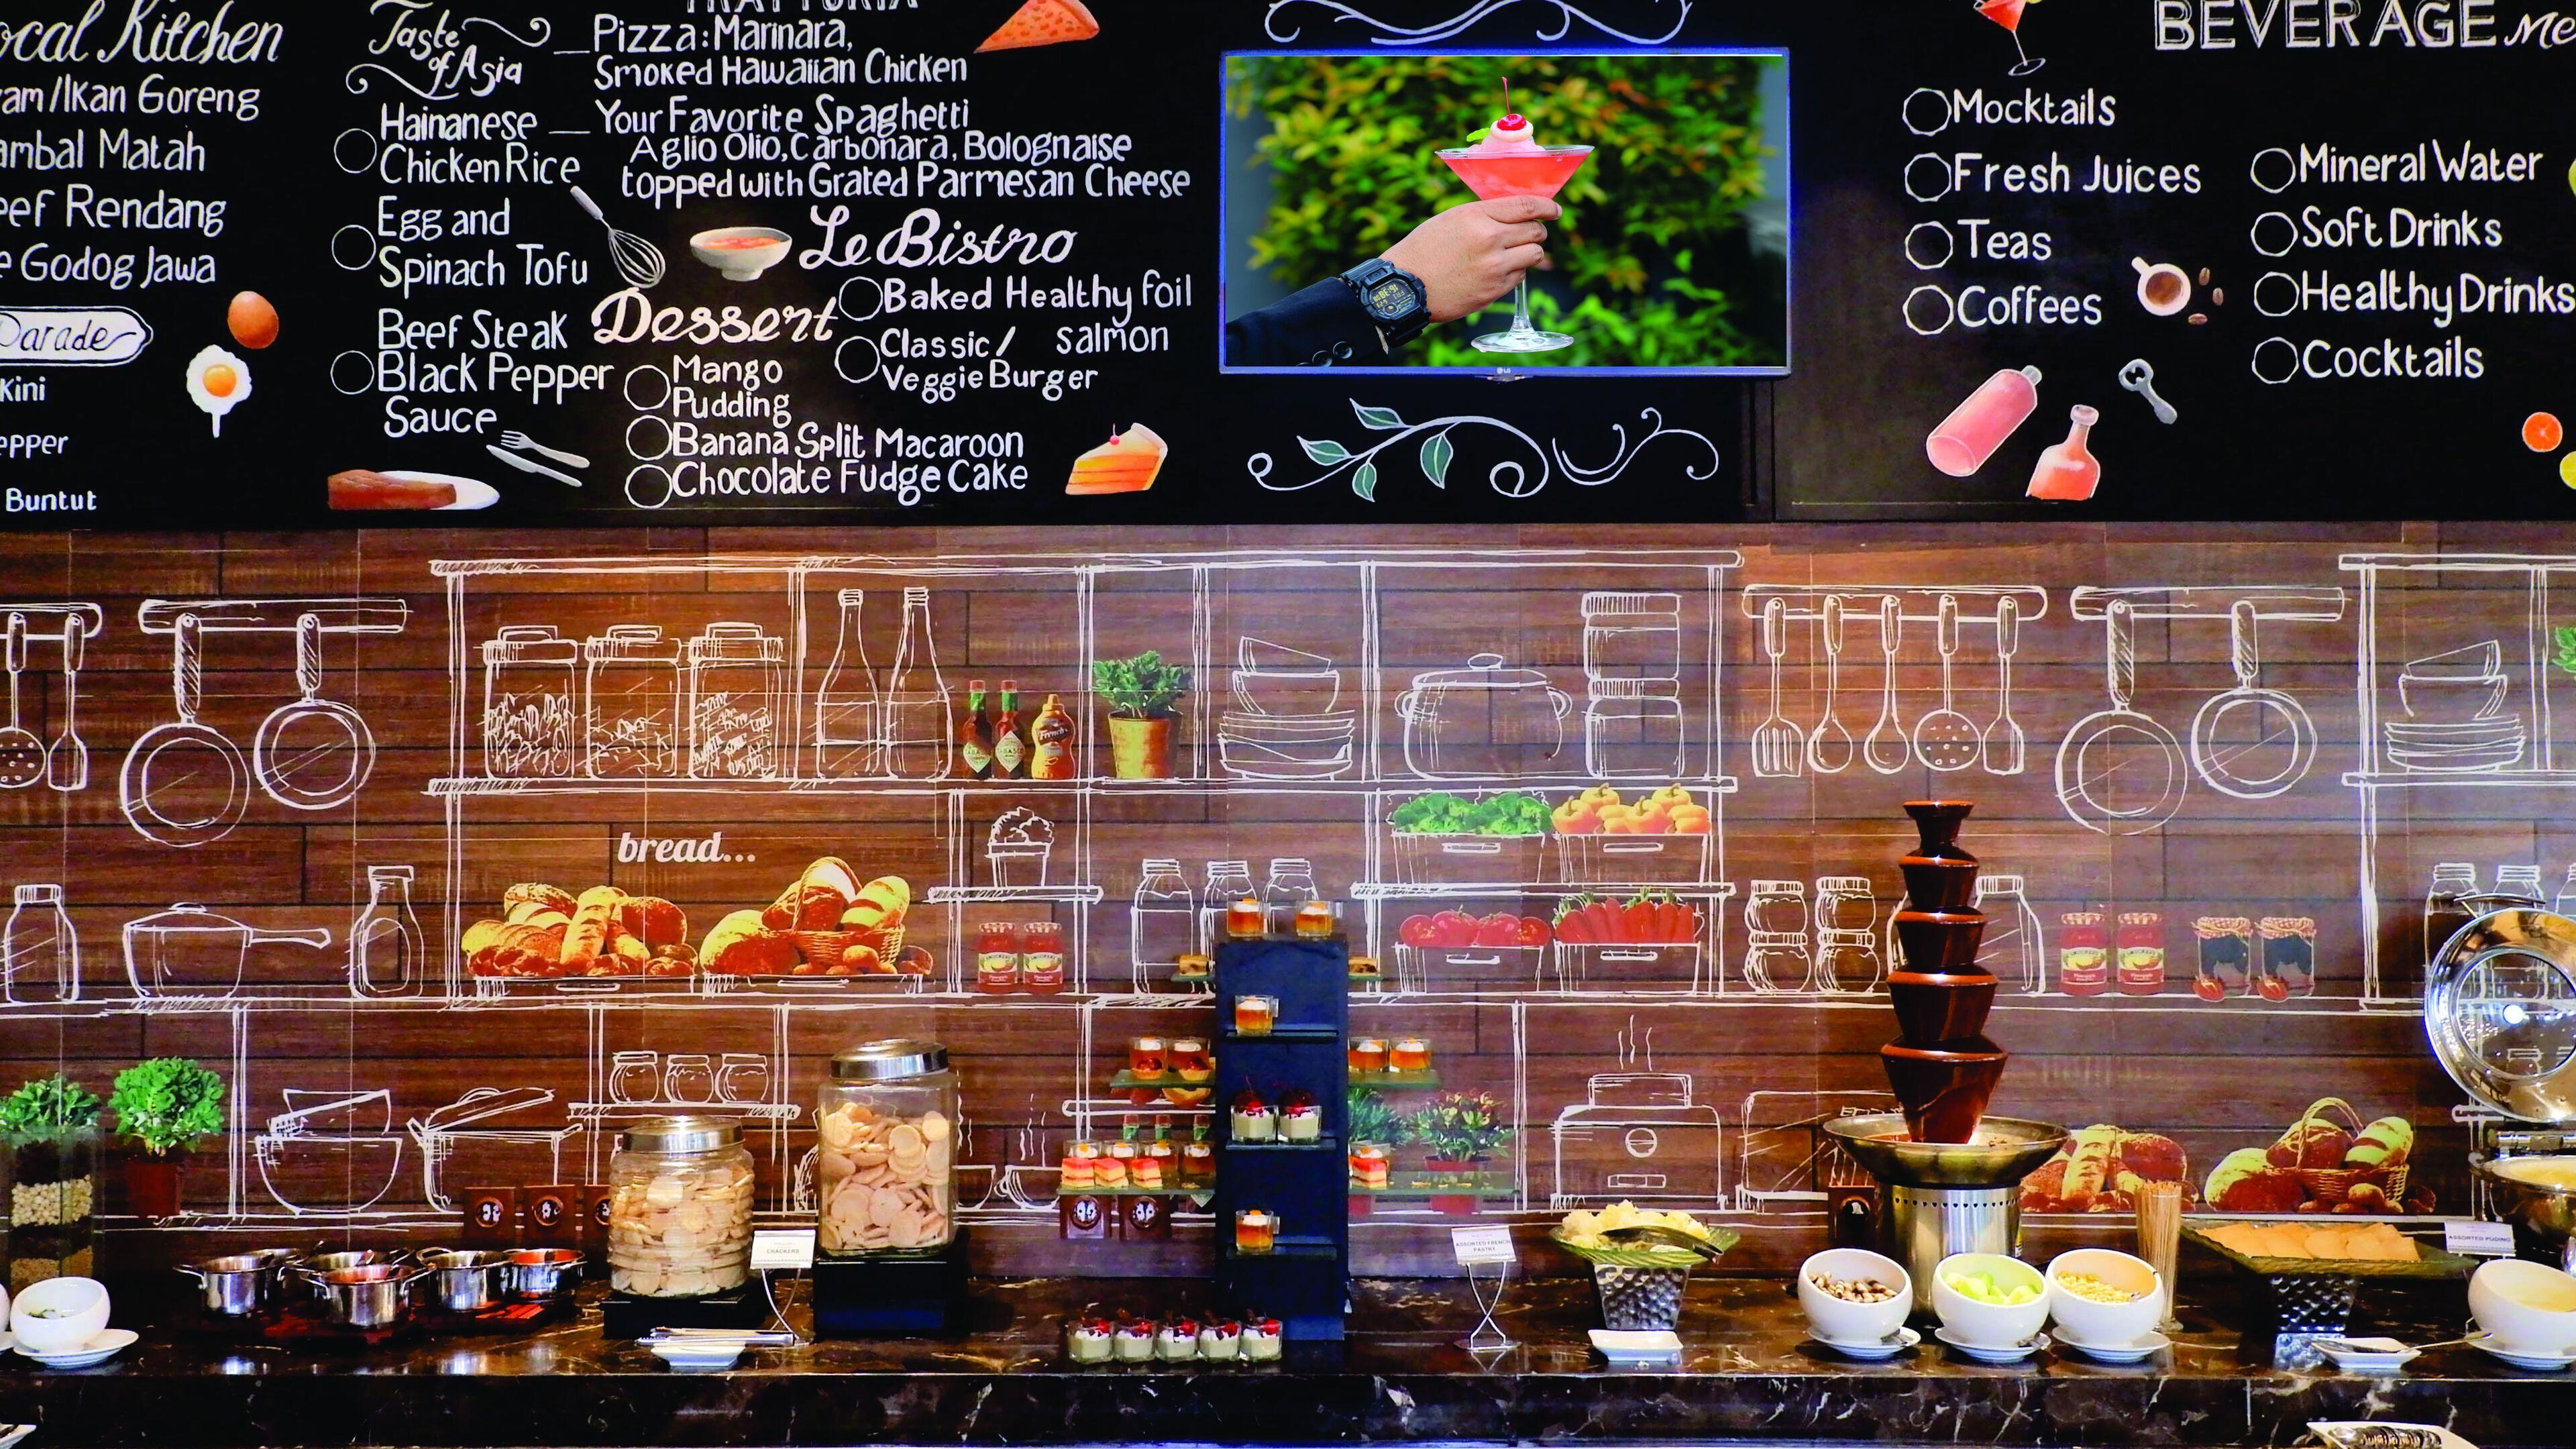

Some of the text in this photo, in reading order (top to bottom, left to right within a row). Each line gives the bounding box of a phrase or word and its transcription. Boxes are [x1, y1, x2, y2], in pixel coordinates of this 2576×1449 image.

[97, 0, 283, 64] Kitchen
[369, 0, 460, 60] Taste
[714, 15, 852, 51] Marinara,
[2155, 0, 2496, 50] BEVERAGE
[428, 44, 522, 97] of Asia
[594, 48, 967, 90] Smoked Hawaiian Chicken
[0, 74, 260, 121] am/Ikan Goreng
[595, 94, 968, 138] Your Favorite Spaghetti
[1954, 88, 2116, 126] Mocktails
[381, 102, 537, 142] Hainanese
[100, 129, 205, 171] Matah
[380, 142, 580, 184] Chicken Rice
[630, 135, 716, 169] Aglio
[965, 131, 1132, 166] Bolognaise
[2300, 139, 2543, 182] Mineral Water
[622, 162, 1190, 209] topped with Grated Parmesan Cheese
[1955, 152, 2200, 193] Fresh Juices
[66, 184, 226, 237] Rendang
[378, 195, 510, 241] Egg and
[2302, 205, 2502, 248] Soft Drinks
[799, 205, 1077, 270] Le Bistro
[1957, 219, 2051, 261] Teas
[21, 243, 135, 290] Godog
[140, 246, 215, 288] Jawa
[379, 244, 587, 299] Spinach Tofu
[591, 286, 838, 345] Dessert
[884, 276, 991, 313] Baked
[1007, 274, 1132, 328] Healthy
[1957, 285, 2102, 327] Coffees
[2302, 269, 2575, 328] Healthy Drinks
[379, 309, 568, 350] Beef Steak
[1057, 323, 1168, 354] salmon
[378, 351, 615, 405] Black Pepper
[674, 354, 782, 390] Mango
[2302, 335, 2483, 378] Cocktails
[882, 360, 1098, 404] Veggie Burger
[384, 395, 496, 437] Sauce
[674, 388, 792, 428] Pudding
[672, 421, 1023, 462] Banana Split Macaroon
[6, 488, 97, 512] Buntut
[672, 458, 1028, 506] Chocolate Fudge Cake
[617, 832, 755, 863] bread...
